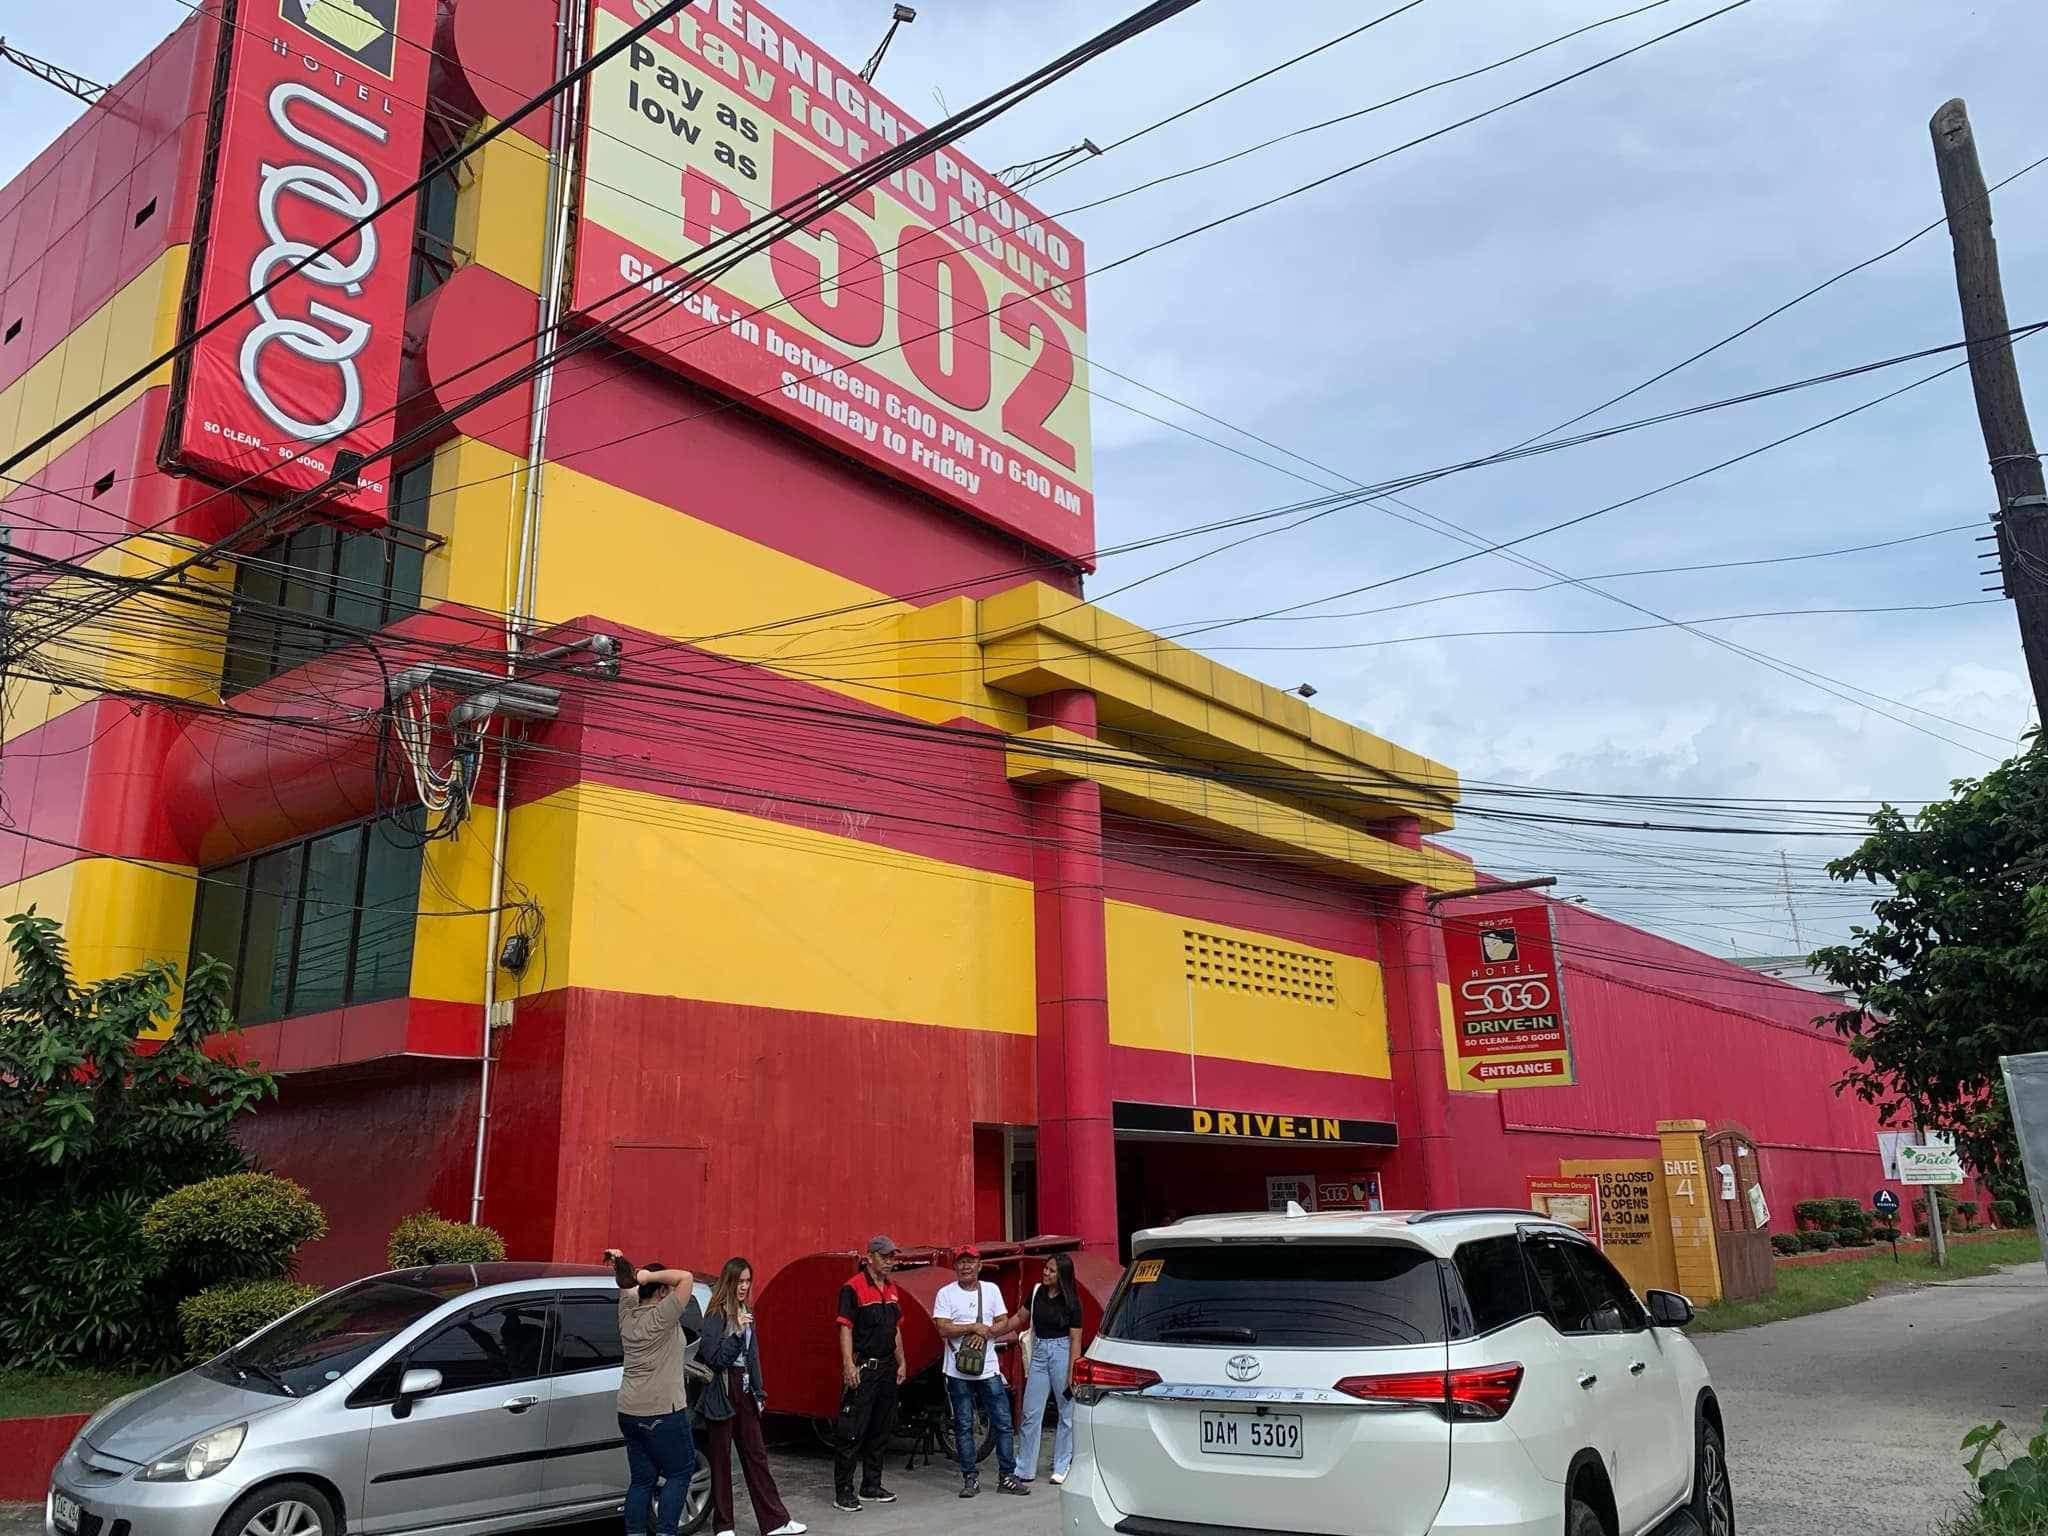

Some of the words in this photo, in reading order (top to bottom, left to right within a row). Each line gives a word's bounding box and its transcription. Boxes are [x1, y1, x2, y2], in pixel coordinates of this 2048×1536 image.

[272, 38, 392, 114] HOTEL
[630, 42, 703, 111] Pay
[716, 102, 759, 142] as
[629, 80, 701, 144] low
[714, 140, 757, 180] as
[692, 0, 922, 163] ERNIGH
[935, 150, 1070, 270] PROMO
[789, 85, 869, 163] for
[949, 195, 1073, 309] hours
[240, 83, 387, 442] SOGO
[620, 253, 760, 346] Check-in
[766, 328, 880, 410] between
[885, 394, 937, 439] 6:00
[942, 422, 974, 460] PM
[978, 443, 1003, 474] TO
[1008, 459, 1051, 498] 6:00
[1054, 485, 1081, 516] AM
[781, 371, 878, 442] Sunday
[882, 425, 907, 454] to
[911, 438, 980, 495] Friday
[204, 421, 220, 434] SO
[278, 446, 294, 460] SO
[357, 477, 383, 493] AFE!
[1471, 963, 1534, 978] HOTEL
[1461, 973, 1551, 1017] SOGO
[1467, 1016, 1554, 1035] DRIVE-IN
[1465, 1039, 1478, 1047] SO
[1531, 1032, 1561, 1042] GOOD!
[1480, 1062, 1553, 1077] ENTRANCE
[1193, 1110, 1341, 1140] DRIVE-IN
[1602, 1174, 1613, 1184] IS
[1615, 1171, 1654, 1184] CLOSED
[1664, 1160, 1698, 1175] GATE
[1611, 1200, 1648, 1210] OPENS
[1633, 1187, 1648, 1197] PM
[1675, 1178, 1695, 1206] 4
[1881, 1190, 1892, 1202] A
[1634, 1214, 1649, 1224] AM
[1163, 1385, 1329, 1401] FORTUNER
[1203, 1421, 1238, 1445] DAM
[1251, 1423, 1298, 1448] 5309
